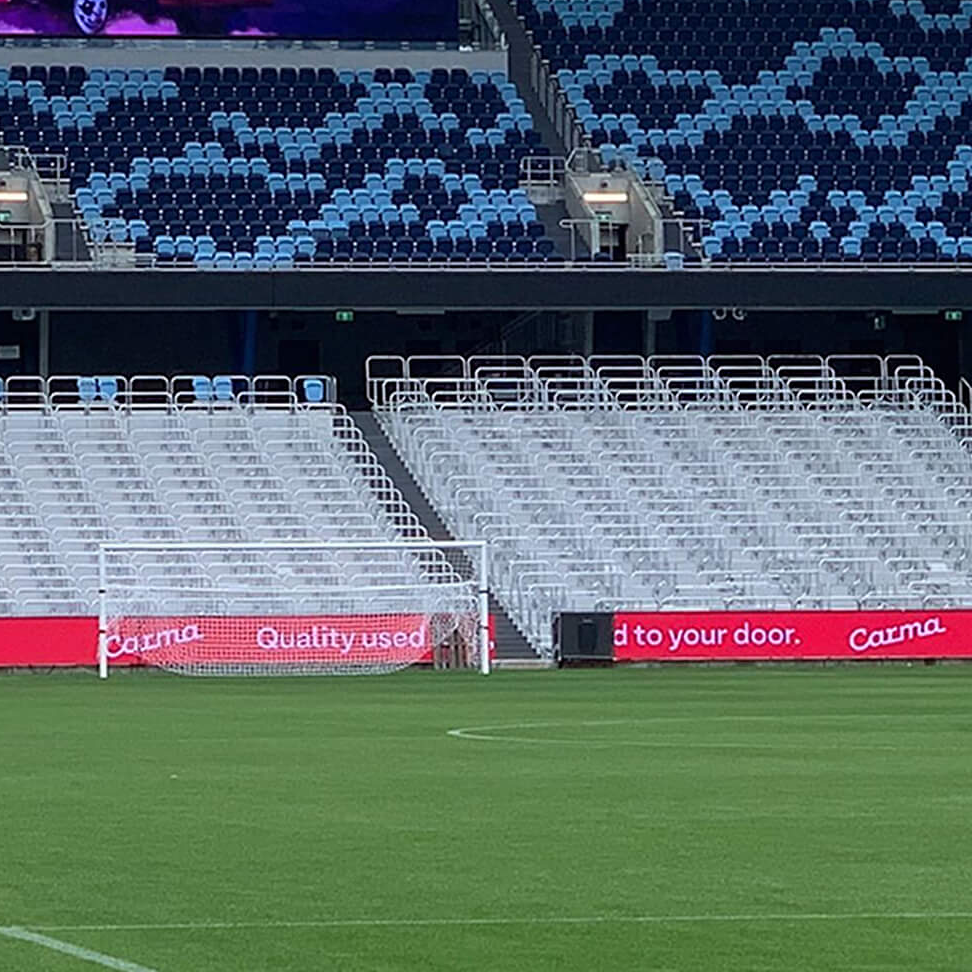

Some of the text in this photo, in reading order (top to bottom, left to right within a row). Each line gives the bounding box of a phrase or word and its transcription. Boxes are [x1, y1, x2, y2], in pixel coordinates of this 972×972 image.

[104, 625, 426, 658] Carma Quality used
[634, 624, 662, 645] to
[668, 627, 728, 651] your
[734, 622, 801, 645] door.
[848, 617, 947, 651] Carma
